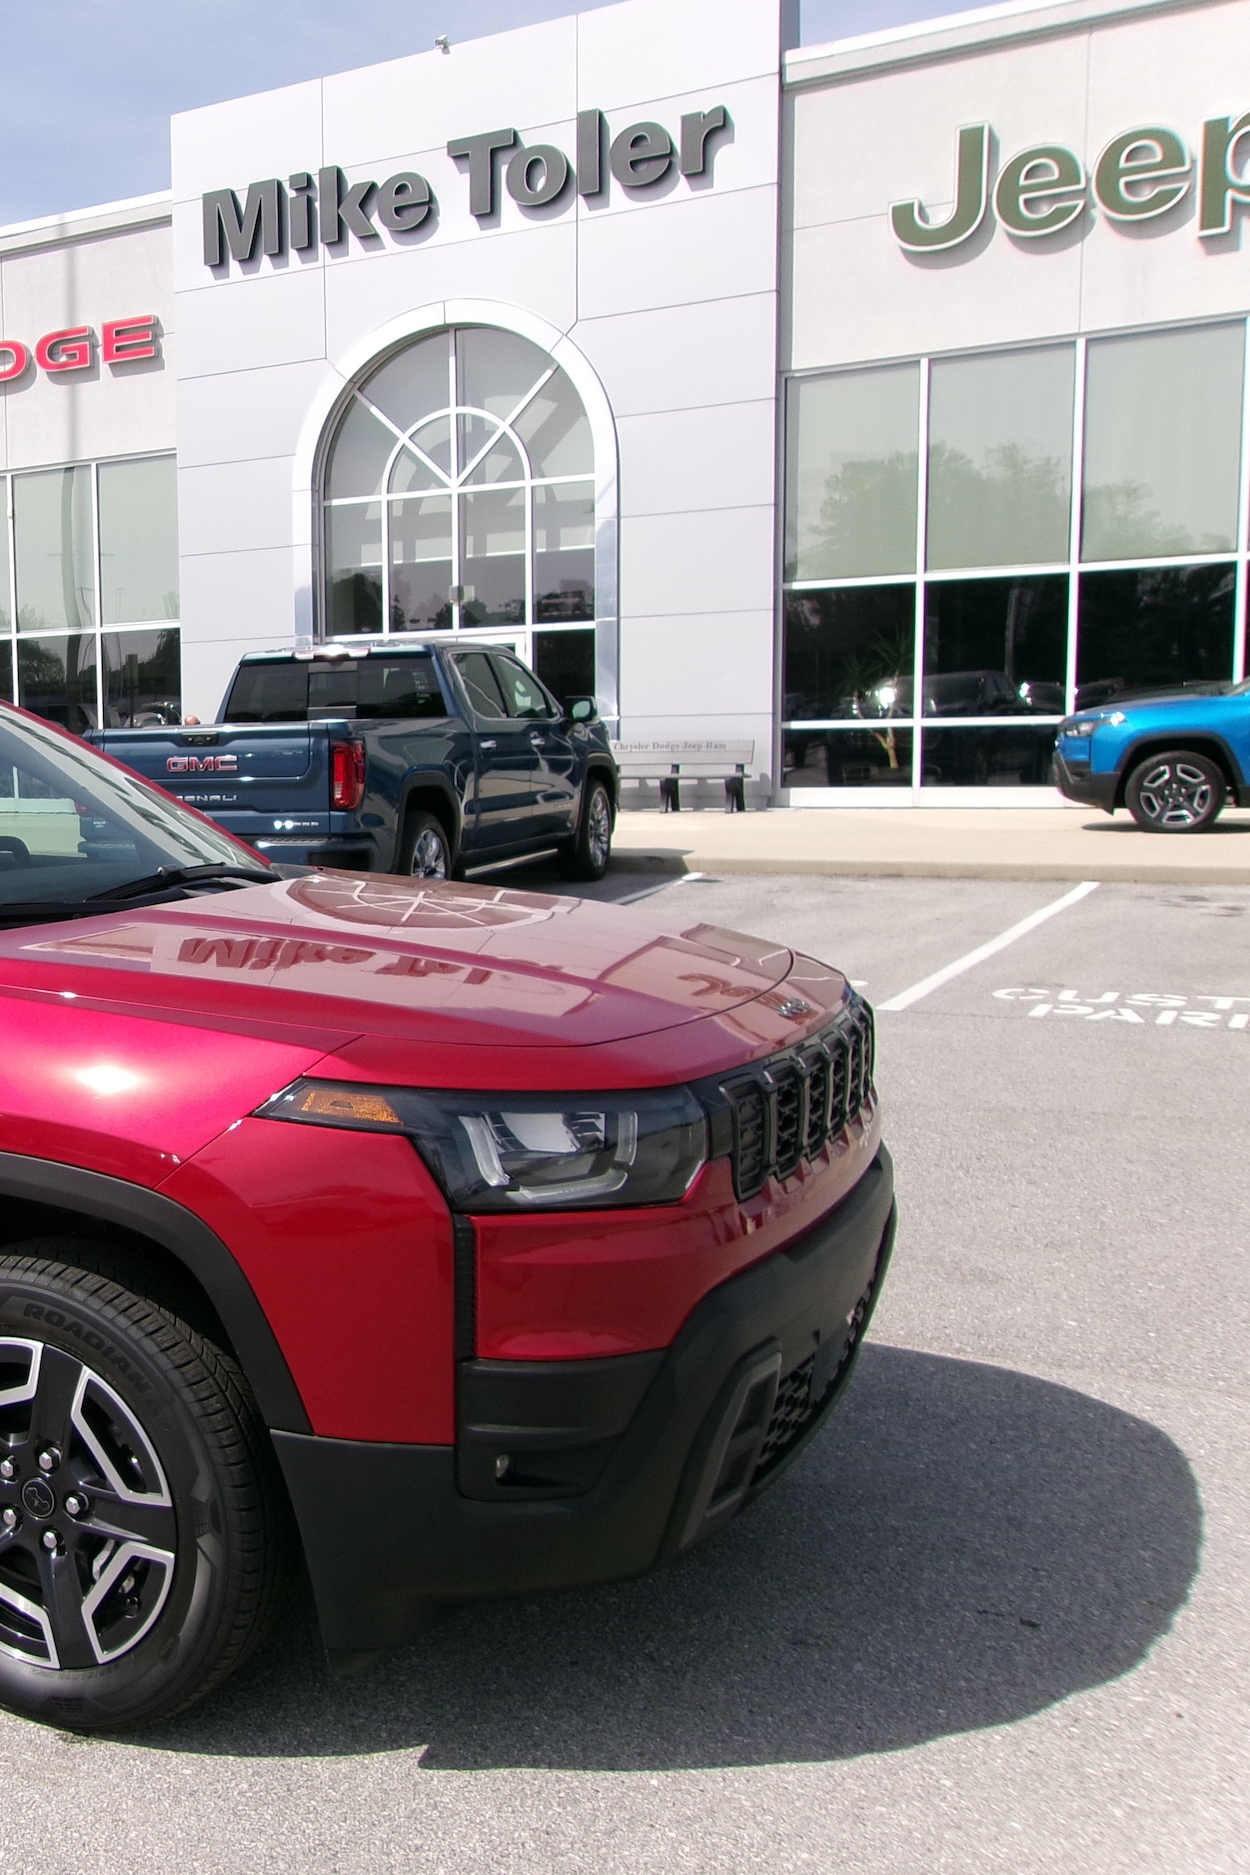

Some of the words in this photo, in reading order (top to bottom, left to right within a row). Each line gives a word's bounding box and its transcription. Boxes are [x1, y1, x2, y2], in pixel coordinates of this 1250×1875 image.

[202, 166, 434, 266] Mike
[447, 105, 731, 217] Toler
[166, 755, 238, 772] GMC
[614, 742, 649, 752] Chrysler
[653, 742, 680, 751] Dodge
[682, 742, 703, 752] Jeep
[23, 1303, 152, 1394] ROADIAN
